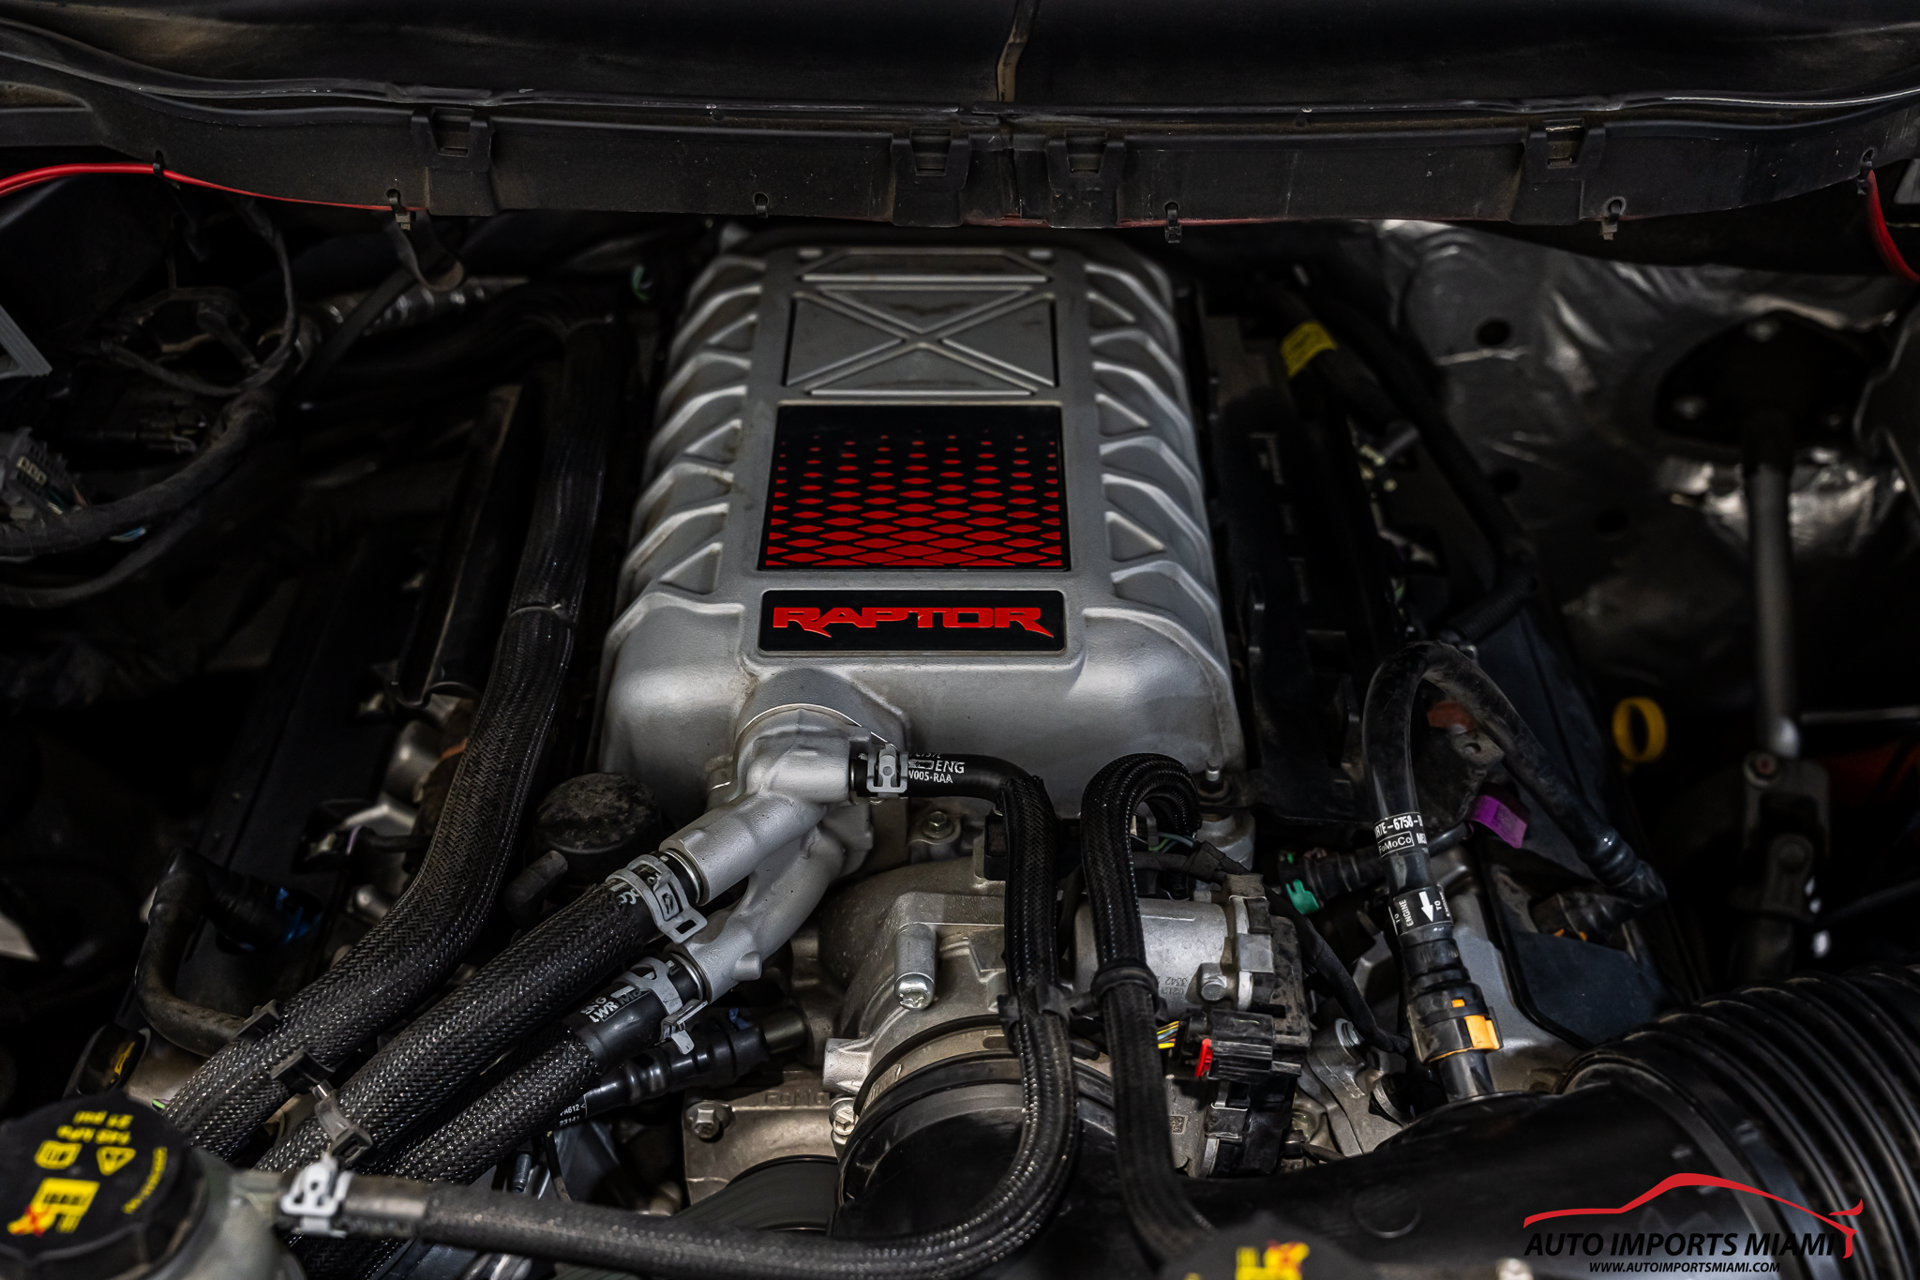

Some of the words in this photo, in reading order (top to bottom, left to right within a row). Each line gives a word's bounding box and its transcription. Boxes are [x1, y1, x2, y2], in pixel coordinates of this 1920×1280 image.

[773, 607, 1054, 638] RAPTOR
[935, 760, 965, 774] ENG
[1379, 836, 1412, 854] FoMoCo
[1398, 899, 1414, 927] ENGINE
[1433, 900, 1442, 911] TO
